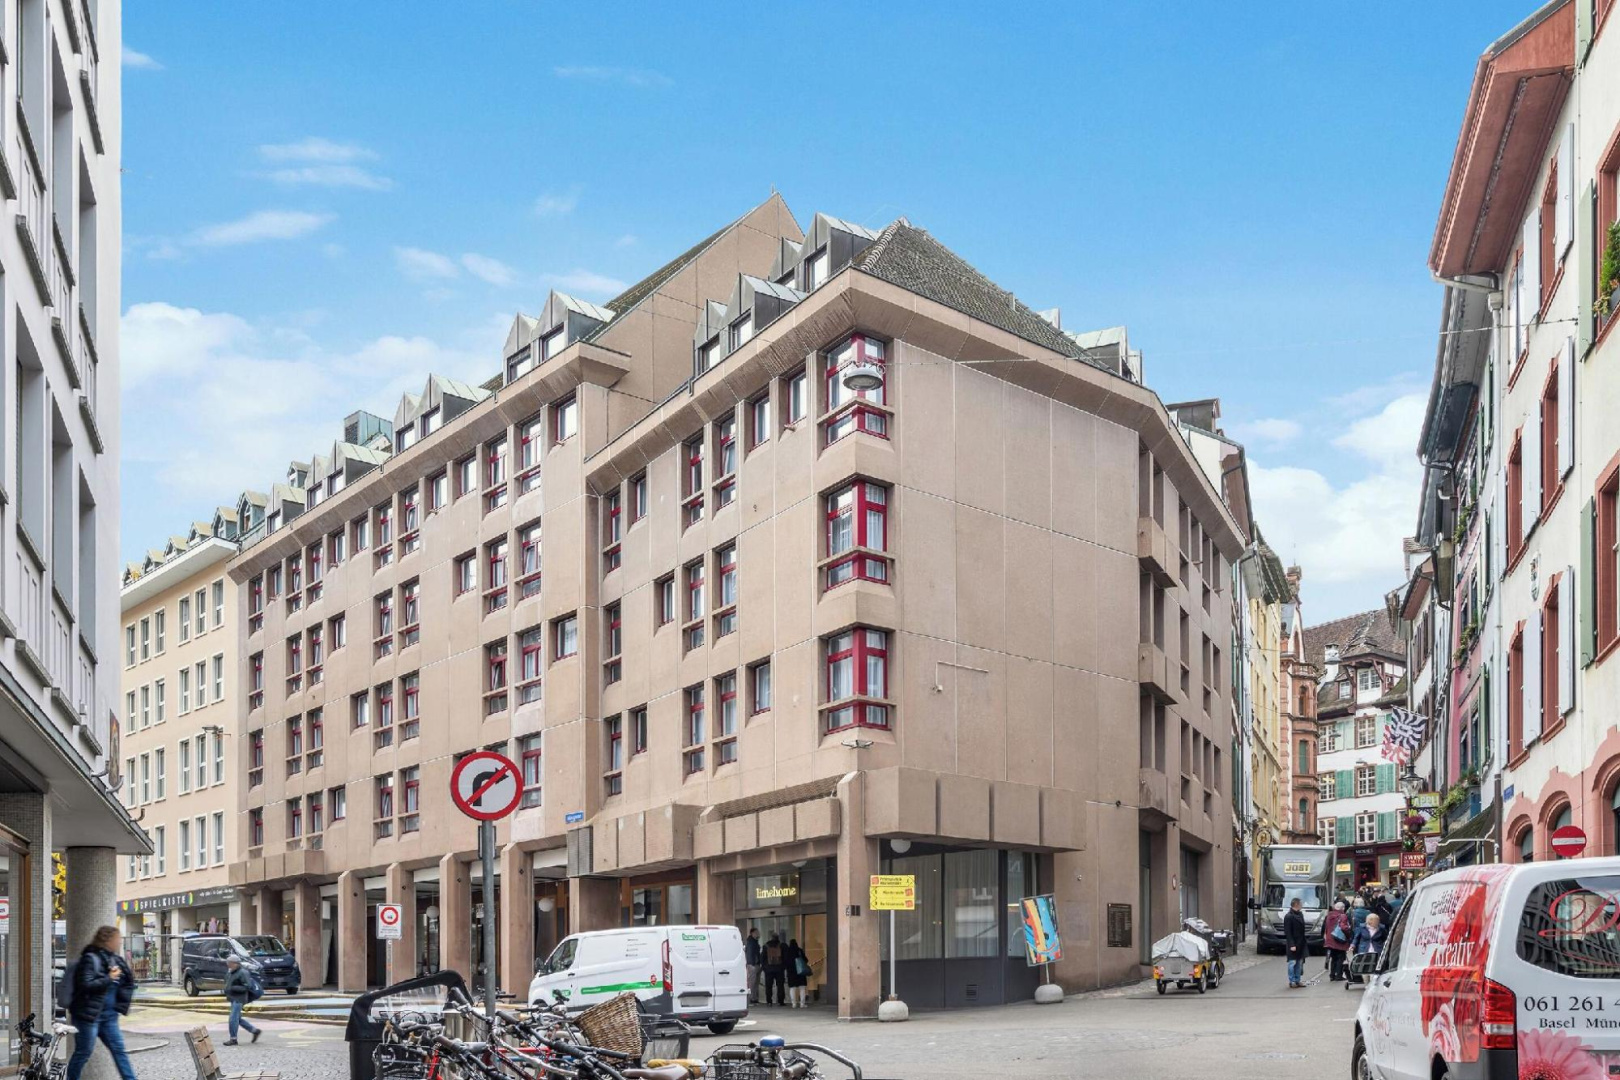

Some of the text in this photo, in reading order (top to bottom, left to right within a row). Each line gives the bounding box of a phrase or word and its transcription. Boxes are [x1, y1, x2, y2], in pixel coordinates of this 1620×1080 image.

[1285, 864, 1310, 872] JOST
[755, 885, 797, 899] limehome
[140, 895, 186, 910] SPIELKISTE
[1433, 932, 1476, 967] kreativ
[1524, 995, 1560, 1012] 061
[1568, 995, 1605, 1012] 261
[1539, 1016, 1575, 1029] Basel
